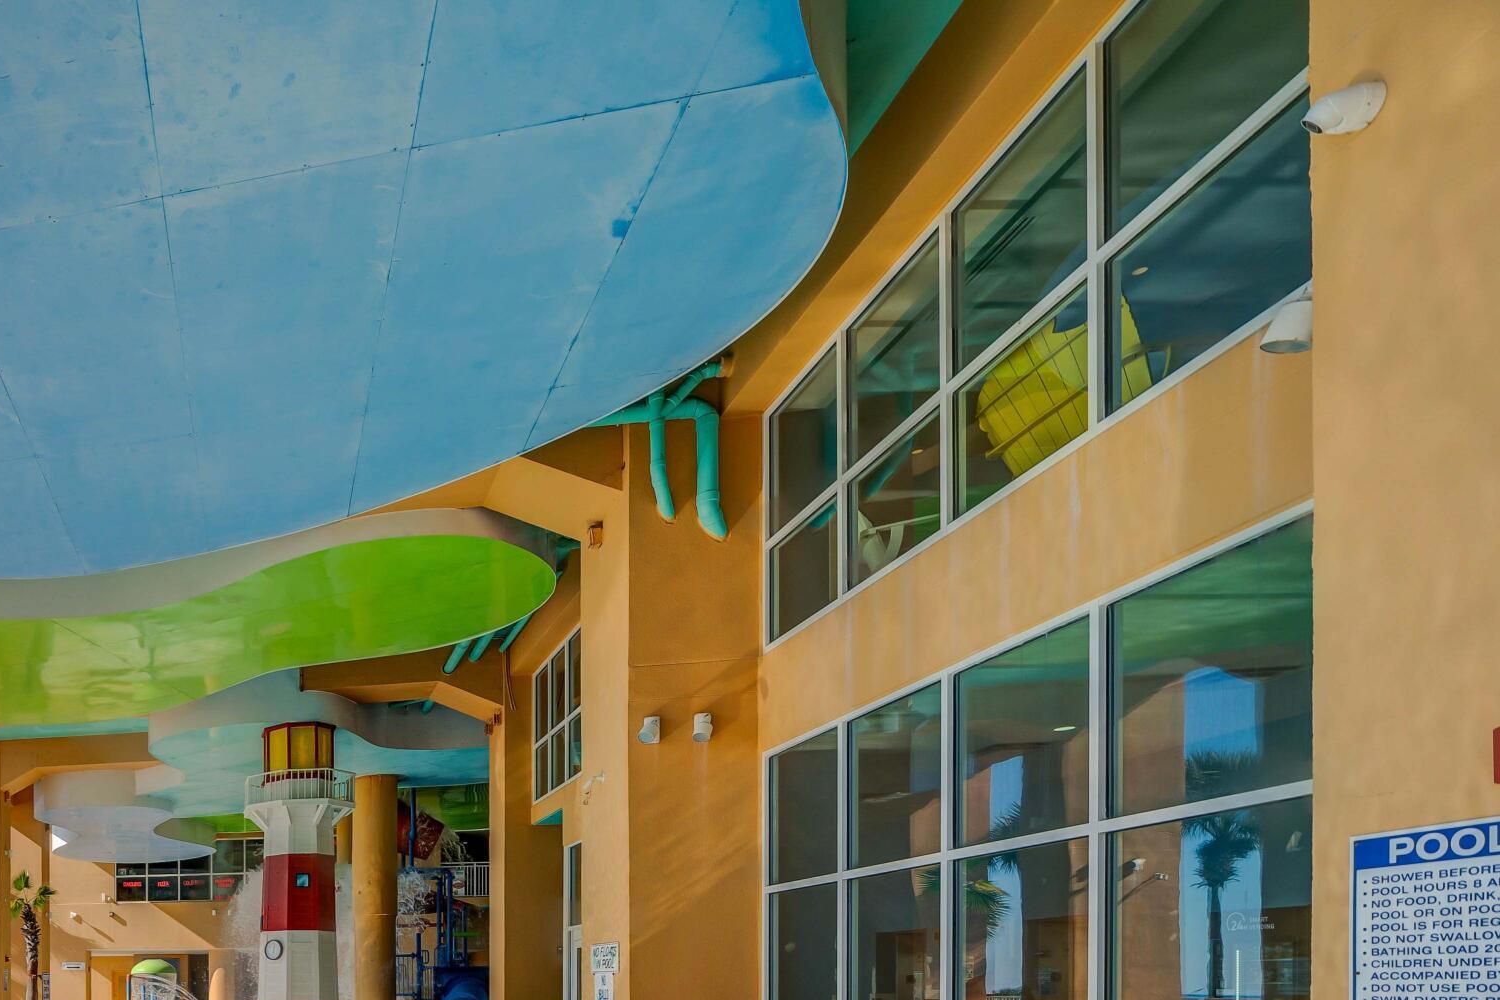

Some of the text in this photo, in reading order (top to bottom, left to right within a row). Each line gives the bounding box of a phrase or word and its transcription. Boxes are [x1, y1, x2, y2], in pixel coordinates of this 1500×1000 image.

[1371, 864, 1500, 885] SHOWER BEFORE
[1371, 877, 1500, 897] POOL HOURS 8 A
[1371, 900, 1391, 909] NO
[1396, 896, 1442, 907] FOOD,
[1371, 910, 1408, 921] POOL
[1414, 909, 1434, 918] OR
[1439, 906, 1462, 916] ON
[1371, 923, 1408, 933] POOL
[1414, 921, 1427, 930] IS
[1432, 920, 1463, 930] FOR
[1371, 936, 1390, 945] DO
[1396, 934, 1425, 944] NOT
[1371, 945, 1433, 957] BATHING
[1437, 944, 1479, 955] LOAD
[1371, 957, 1443, 969] CHILDREN
[1370, 970, 1500, 981] ACCOMPANIED B
[1371, 983, 1390, 993] DO
[1395, 983, 1425, 993] NOT
[1429, 983, 1461, 993] USE
